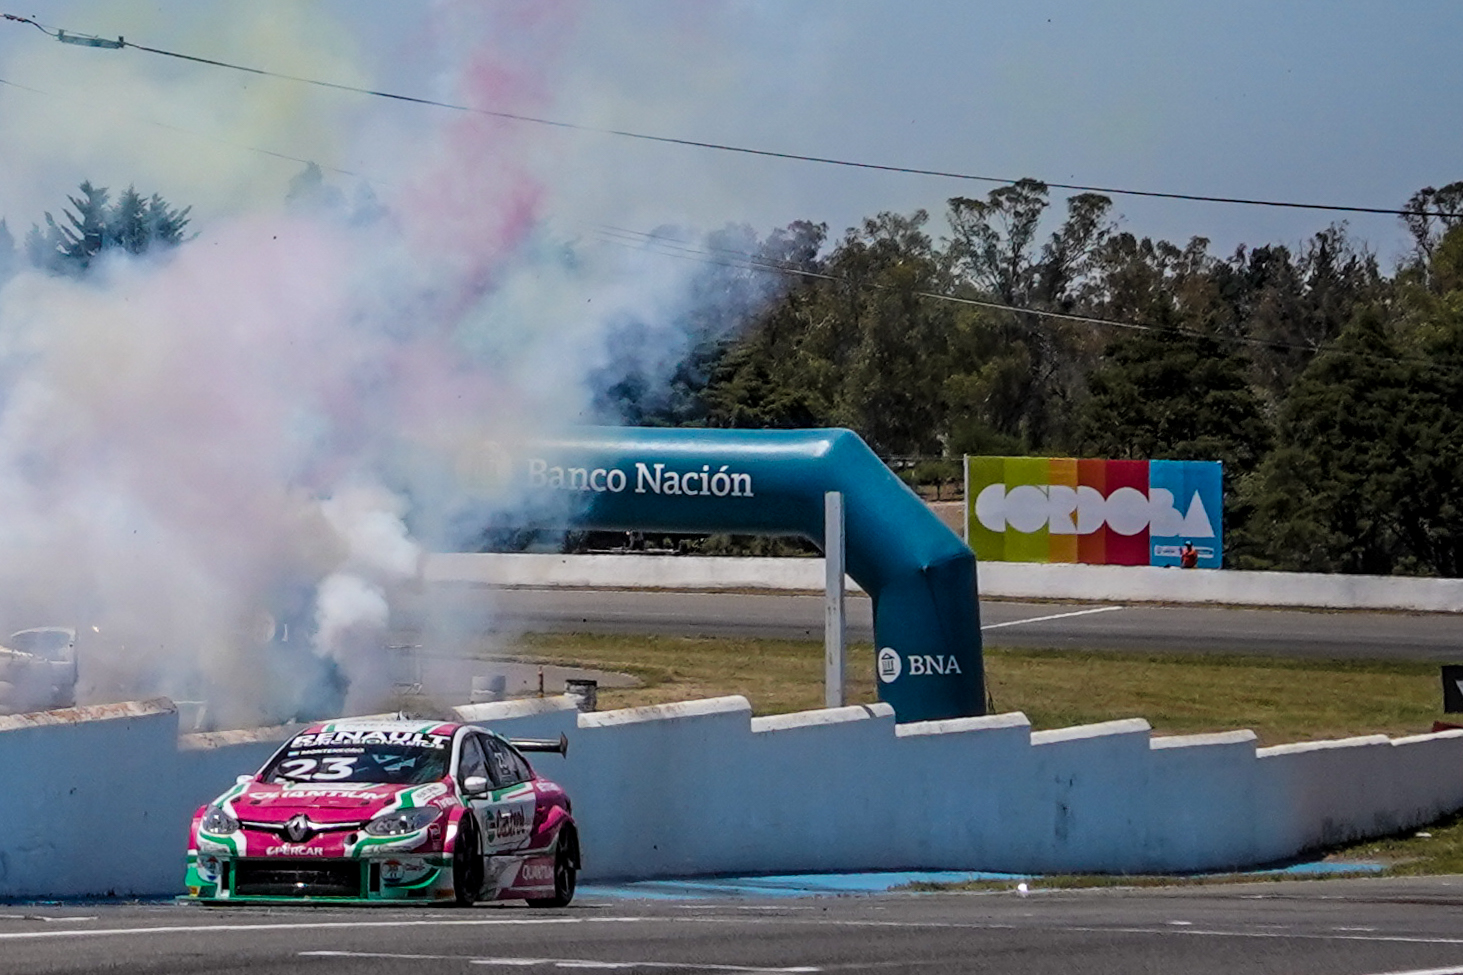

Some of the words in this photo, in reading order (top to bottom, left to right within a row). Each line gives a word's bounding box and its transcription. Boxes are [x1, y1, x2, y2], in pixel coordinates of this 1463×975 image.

[527, 458, 627, 493] Banco
[634, 461, 755, 498] Nación
[907, 654, 963, 676] BNA
[291, 731, 452, 748] RENAULT
[282, 757, 359, 781] 23
